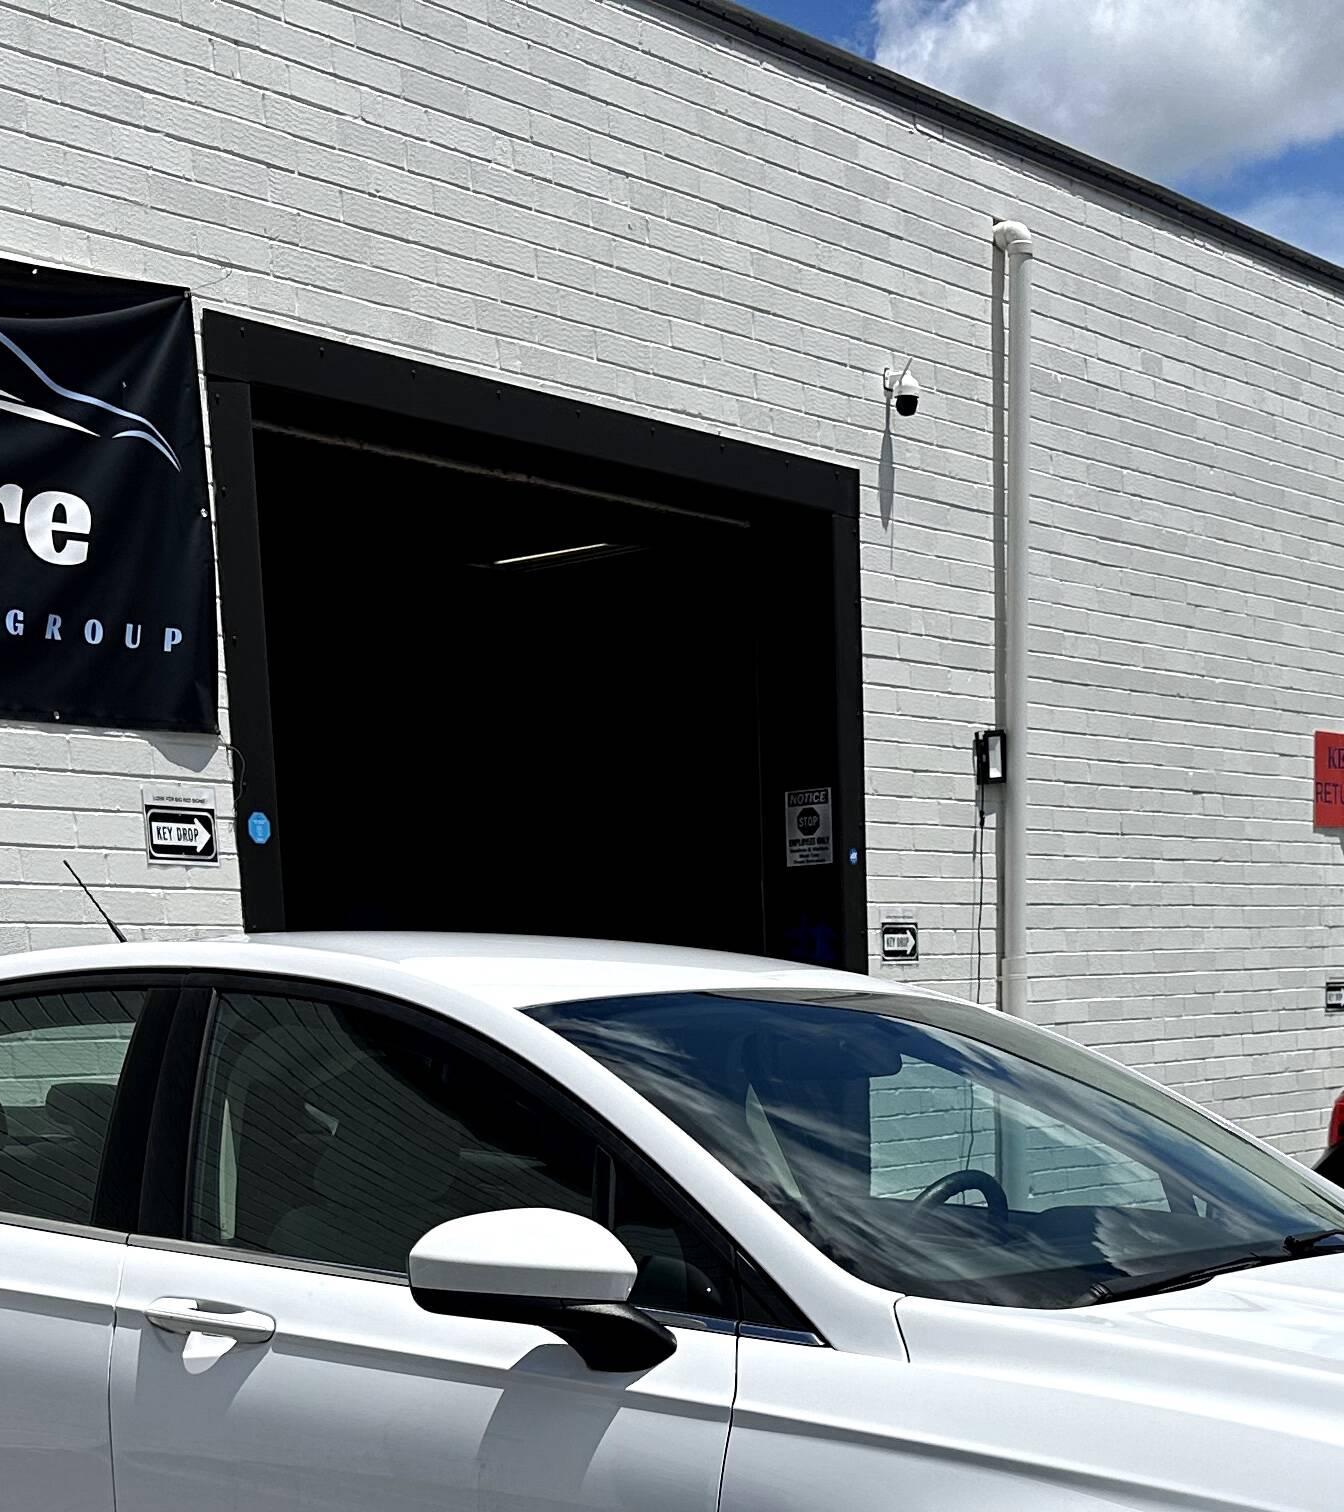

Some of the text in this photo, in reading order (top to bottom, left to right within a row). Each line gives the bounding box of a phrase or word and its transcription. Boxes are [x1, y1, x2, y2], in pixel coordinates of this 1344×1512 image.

[4, 607, 185, 654] GROUP
[789, 790, 826, 806] NOTICE
[798, 816, 818, 828] STOP
[156, 825, 199, 843] KEY DROP
